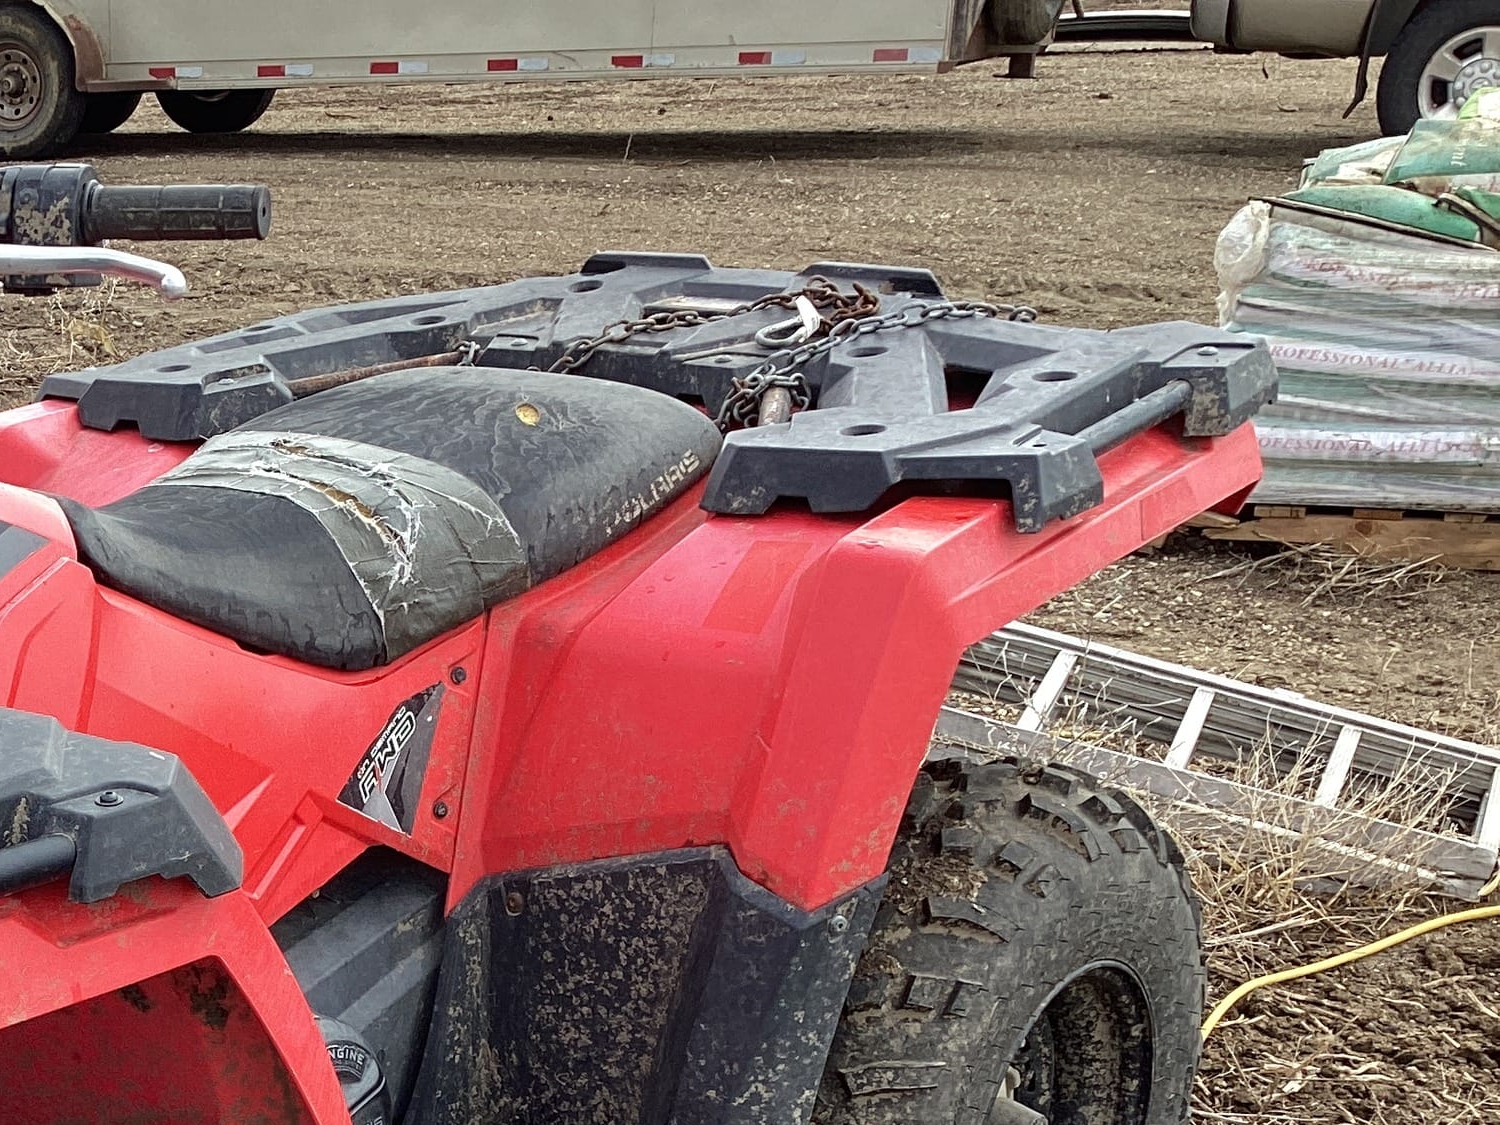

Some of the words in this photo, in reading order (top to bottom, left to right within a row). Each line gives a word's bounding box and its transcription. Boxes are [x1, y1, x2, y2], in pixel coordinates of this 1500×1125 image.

[1270, 345, 1398, 369] ROFESSIONAL
[1414, 357, 1469, 376] ALLIA
[1259, 437, 1373, 452] OFESSIONAL
[327, 1048, 365, 1066] NGINE
